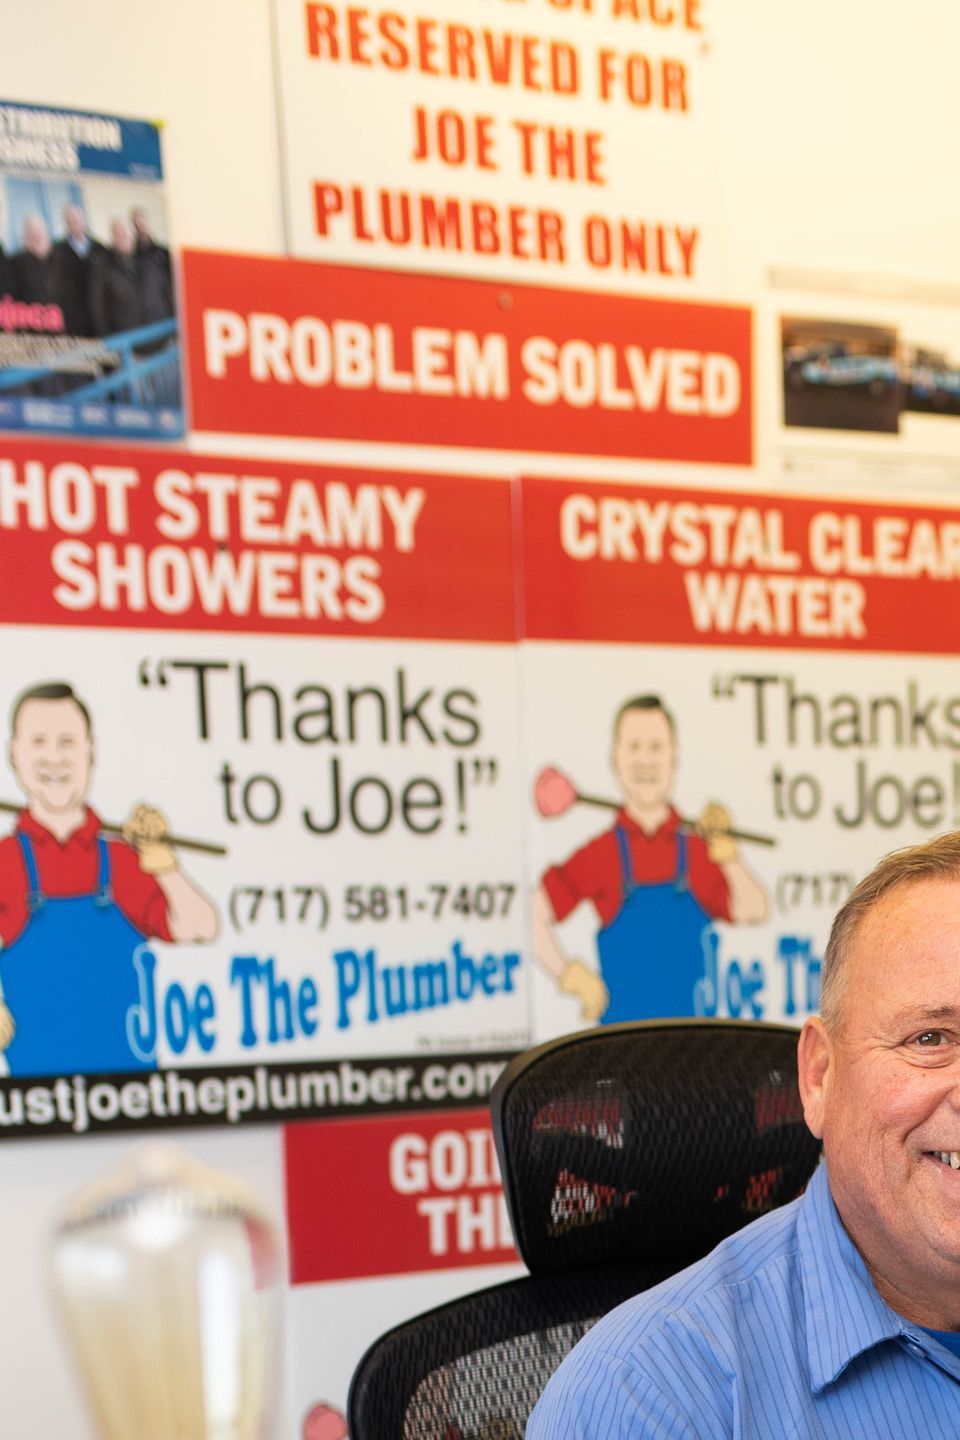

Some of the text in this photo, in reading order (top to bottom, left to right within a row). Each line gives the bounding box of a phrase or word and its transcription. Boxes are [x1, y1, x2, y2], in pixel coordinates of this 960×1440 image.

[306, 3, 689, 114] RESERVED FOR
[414, 106, 606, 186] JOE THE
[312, 181, 699, 278] PLUMBER ONLY
[203, 309, 508, 400] PROBLEM
[522, 337, 741, 418] SOLVED
[0, 459, 425, 552] HOT STEAMY
[560, 493, 802, 571] CRYSTAL
[51, 539, 385, 623] SHOWERS
[685, 571, 866, 639] WATER
[138, 658, 481, 747] “Thanks
[220, 757, 499, 835] to Joe!”
[769, 763, 821, 821] to
[230, 884, 517, 931] (717) 581-7407
[126, 940, 521, 1062] Joe The Plumber
[693, 923, 764, 1019] Joe
